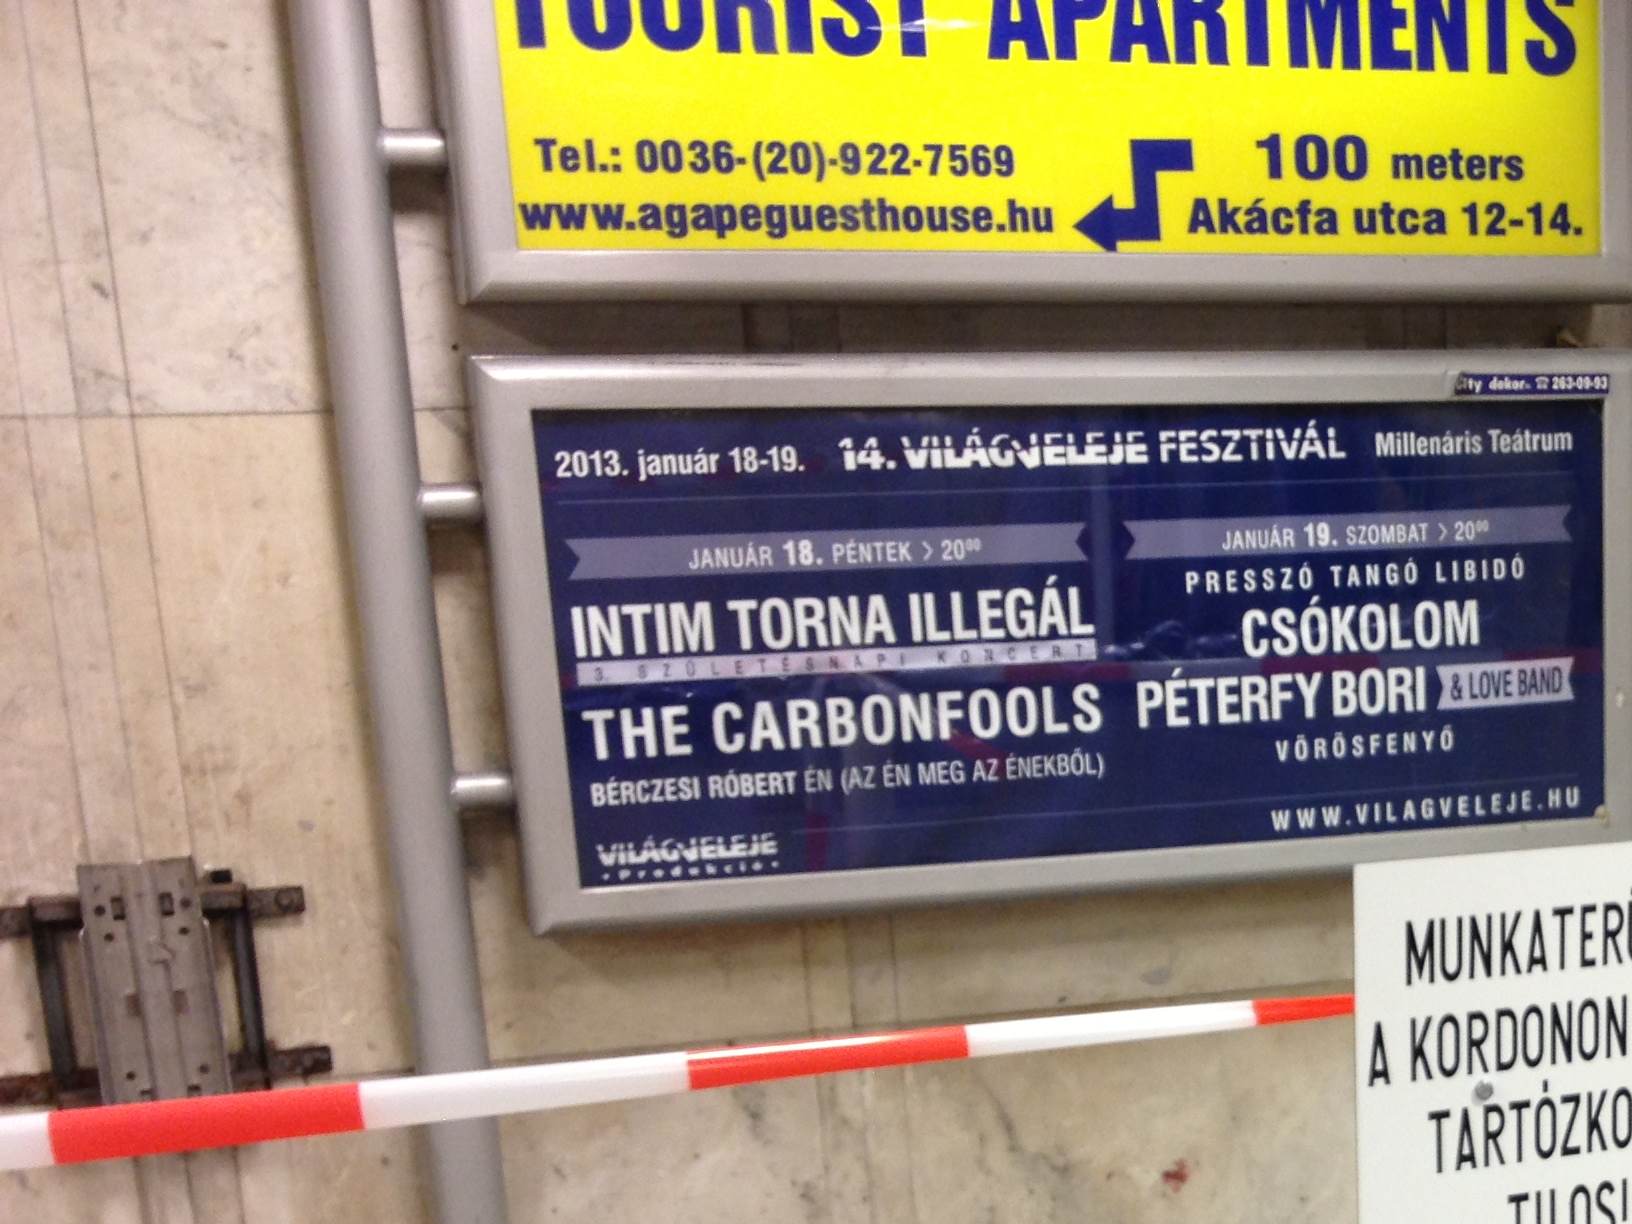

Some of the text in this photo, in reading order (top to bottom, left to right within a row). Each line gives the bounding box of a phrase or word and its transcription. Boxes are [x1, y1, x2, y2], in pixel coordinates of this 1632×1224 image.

[533, 138, 1014, 181] Tel.: 0036-(20)-922-7569
[1256, 134, 1524, 181] 100 meters
[519, 199, 1053, 240] www.agapeguesthouse.hu
[1188, 197, 1584, 238] Akácfa utca 12-14.
[555, 419, 1574, 482] 2013. január 18-19. 14. VILÁGVELEJE FESZTIVÁL Millenáris Teátrum
[688, 539, 774, 571] JANUÁR
[782, 540, 824, 567] 18.
[832, 539, 912, 565] PÉNTEK
[1222, 523, 1295, 551] JANUÁR
[1304, 522, 1338, 548] 19.
[1346, 521, 1429, 547] SZOMBAT
[1185, 551, 1525, 595] PRESSZÓ TANGÓ LIBIDÓ
[570, 579, 1096, 659] INTIM TORNA ILLEGÁL
[1241, 595, 1480, 658] CSÓKOLOM
[935, 643, 1086, 665] KONCERT
[1137, 665, 1564, 729] PÉTERFY BORI & LOVE BAND
[582, 682, 1104, 761] THE CARBONFOOLS
[590, 747, 1106, 808] BÉRCZESI RÓBERT ÉN (AZ ÉN MEG AZ ÉNEKBŐL)
[1270, 785, 1581, 833] WWW.VILAGVELEJE.HU
[1367, 1021, 1392, 1088] A
[1410, 993, 1628, 1082] KORDONON
